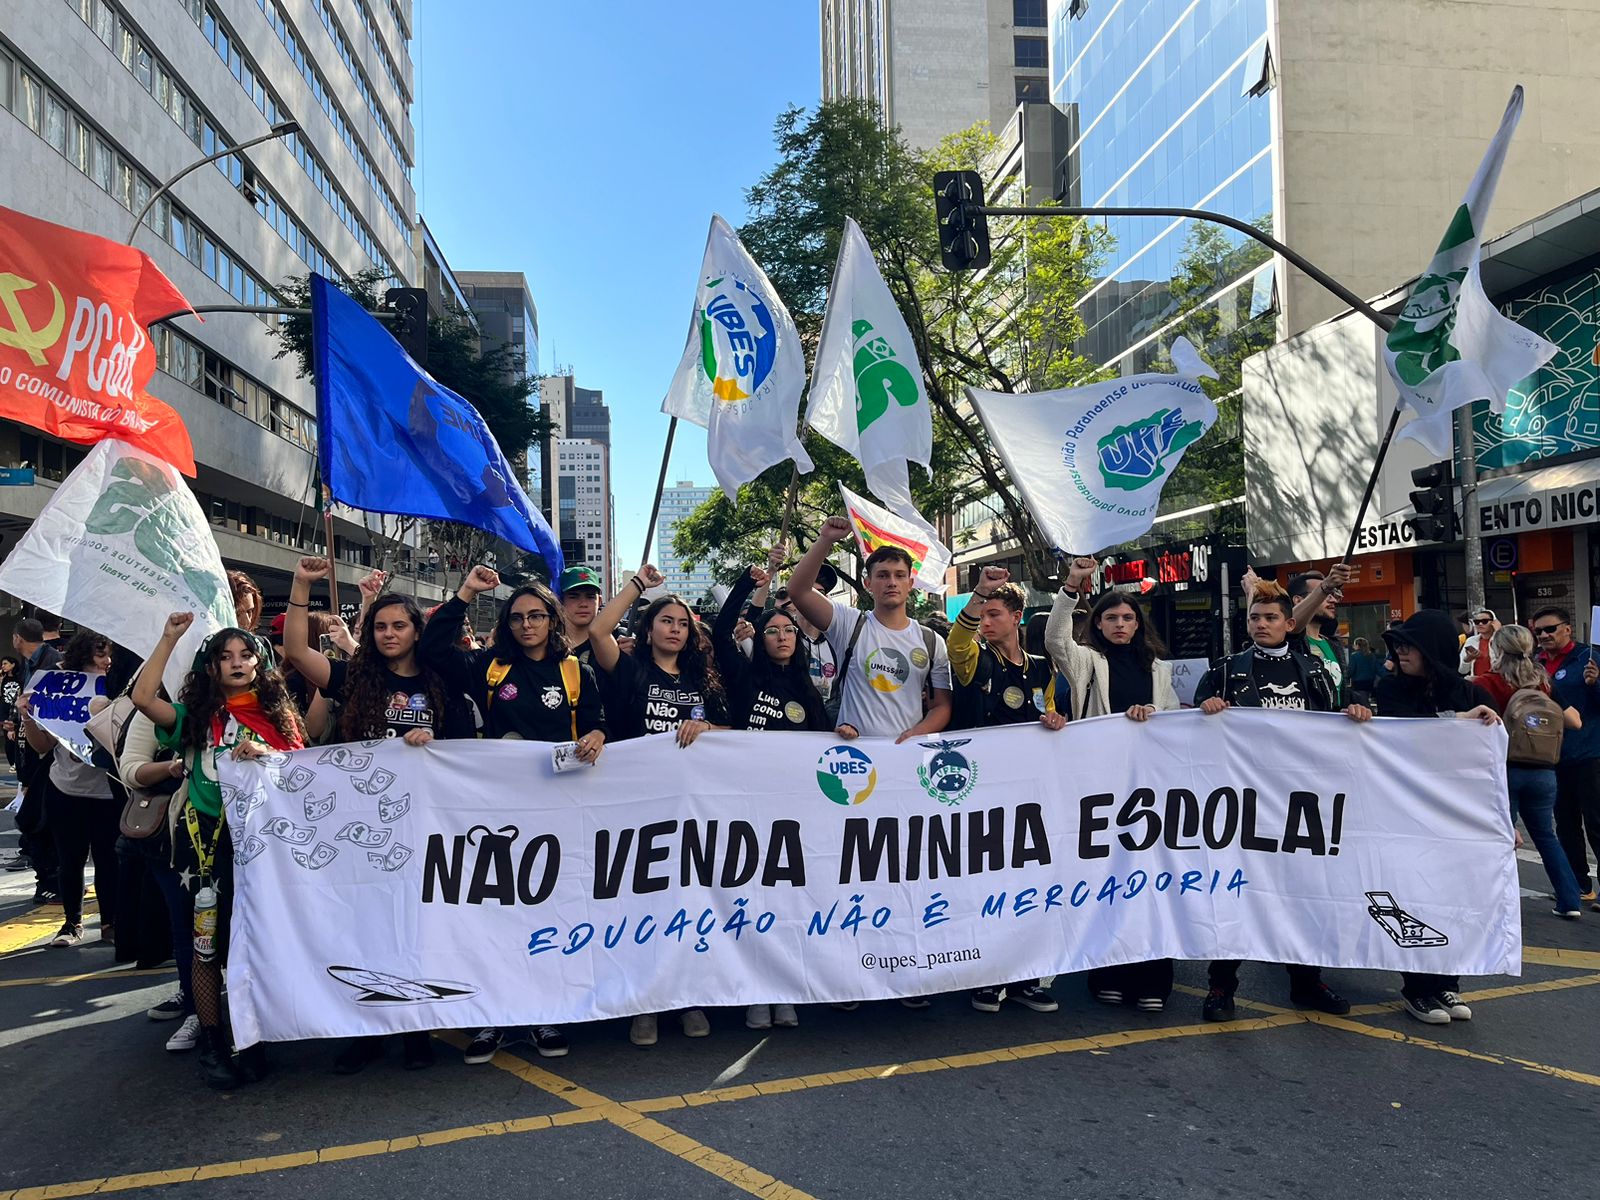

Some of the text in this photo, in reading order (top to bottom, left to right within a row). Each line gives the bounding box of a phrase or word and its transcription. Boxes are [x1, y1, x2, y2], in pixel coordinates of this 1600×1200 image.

[706, 294, 755, 377] UBES
[15, 372, 100, 421] COMUNISTA
[1065, 385, 1129, 440] Paranaense
[1537, 587, 1552, 596] 536
[646, 701, 678, 718] Não
[749, 714, 767, 725] um
[753, 703, 783, 719] como
[829, 761, 868, 775] UBES
[421, 825, 561, 906] NÃO
[593, 818, 806, 900] VENDA
[839, 802, 1052, 885] MINHA
[527, 867, 1250, 956] EDUCAÇÃO NÃO É MERCADORIA
[861, 945, 982, 973] @upes_parana
